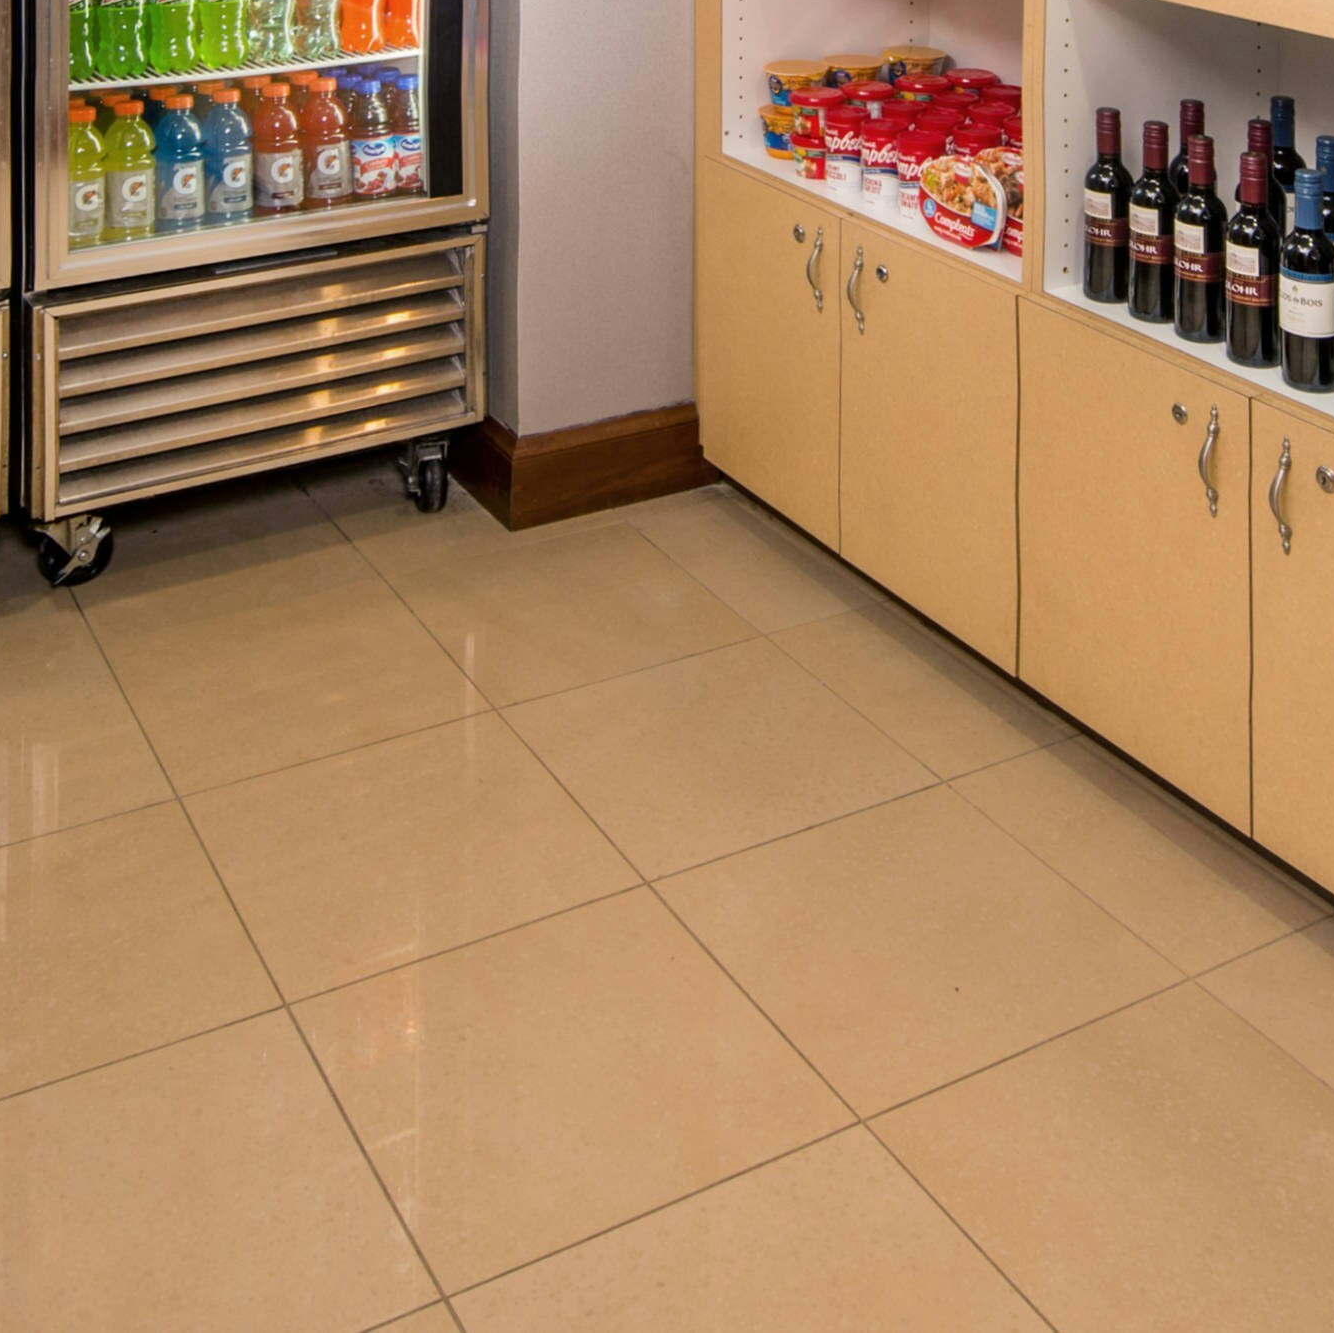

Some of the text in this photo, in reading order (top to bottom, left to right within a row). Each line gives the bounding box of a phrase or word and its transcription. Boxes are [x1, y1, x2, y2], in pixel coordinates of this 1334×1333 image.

[223, 161, 247, 188] G
[271, 157, 294, 183] G
[318, 149, 341, 174] G
[121, 175, 147, 202] G
[173, 167, 197, 194] G
[75, 185, 99, 211] G
[1301, 297, 1324, 308] BOIS
